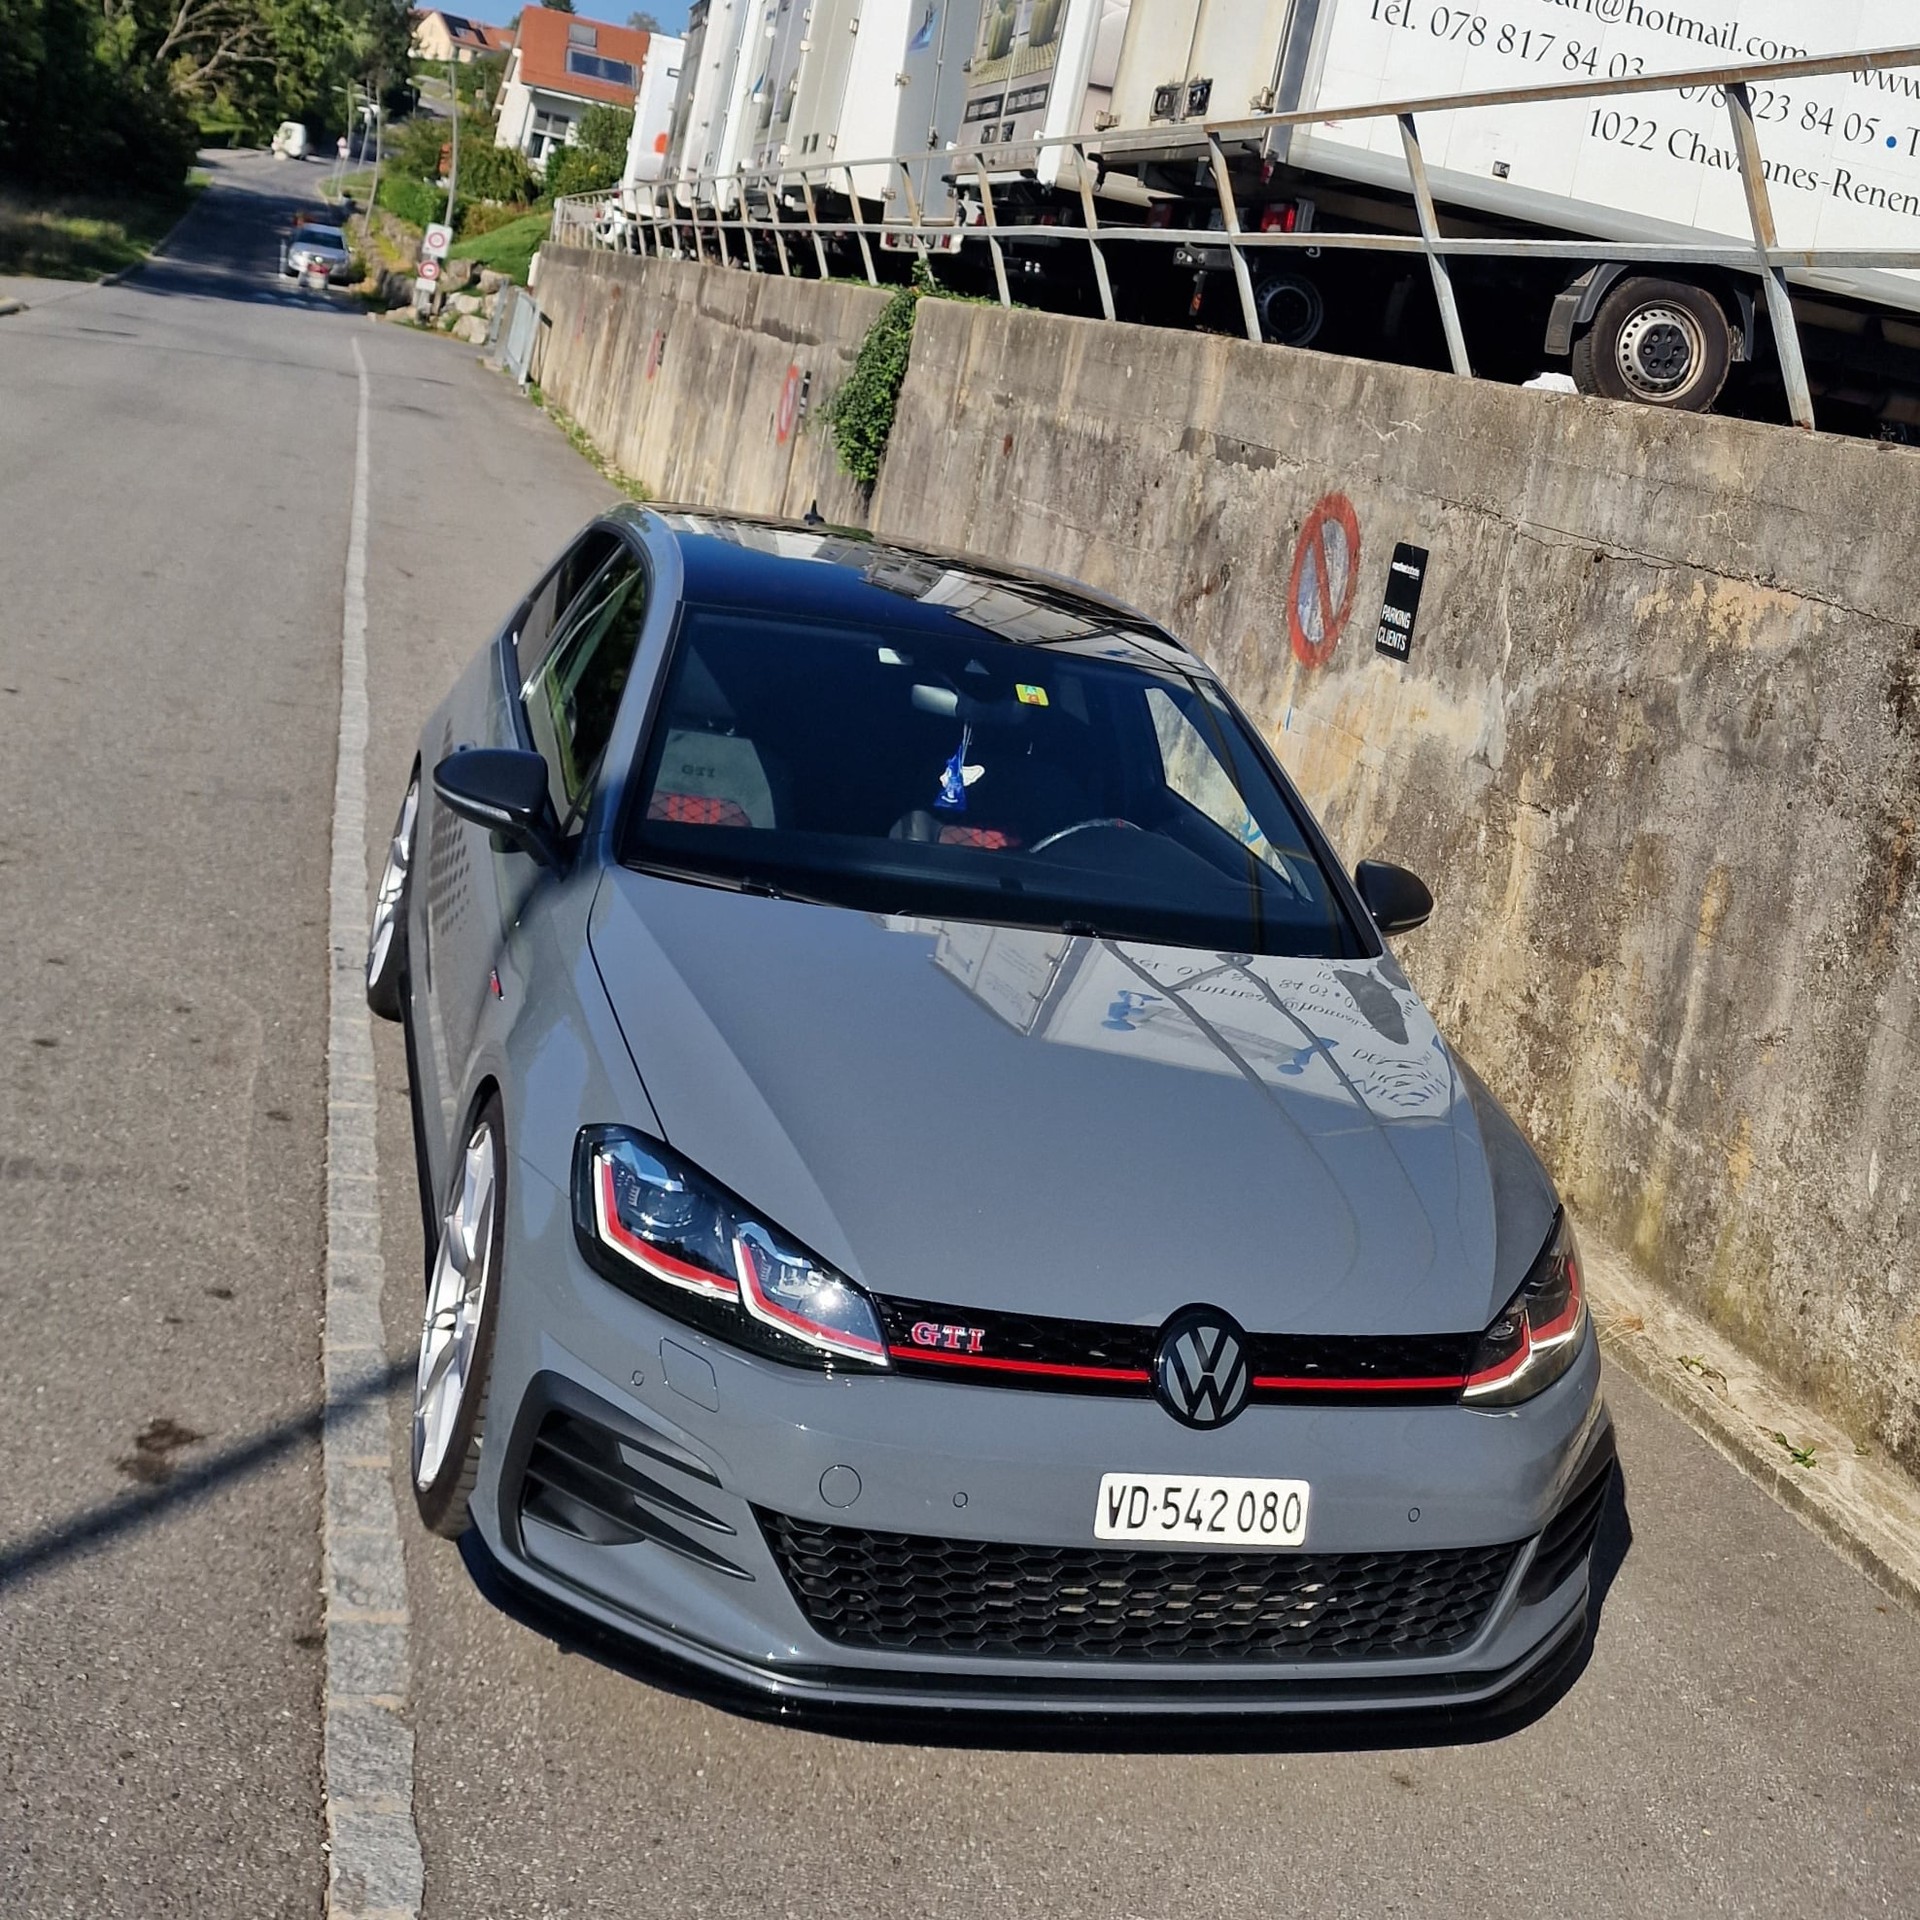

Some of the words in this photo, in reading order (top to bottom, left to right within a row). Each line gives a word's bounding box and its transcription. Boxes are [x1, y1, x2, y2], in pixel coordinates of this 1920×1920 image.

[1431, 6, 1487, 46] 078
[1497, 23, 1556, 62] 817
[1562, 40, 1599, 76] 84
[1800, 101, 1834, 136] 84
[1844, 112, 1882, 144] 05
[1590, 108, 1657, 151] 1022
[1667, 128, 1920, 218] Chavnnes-Renen
[1381, 604, 1412, 629] PARKING
[1377, 626, 1408, 651] CLIENTS
[911, 1321, 986, 1352] GTI
